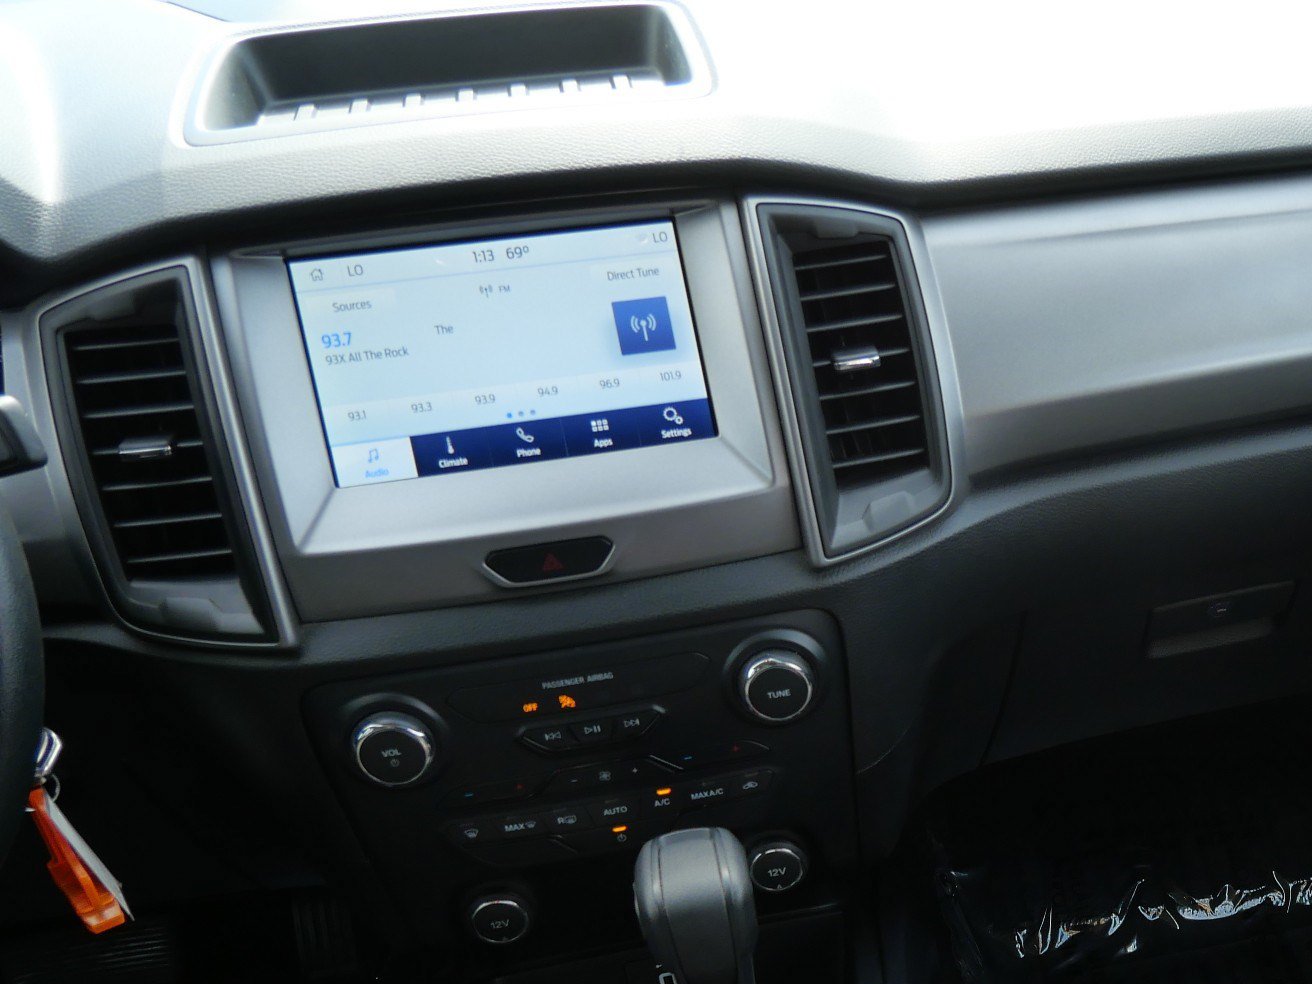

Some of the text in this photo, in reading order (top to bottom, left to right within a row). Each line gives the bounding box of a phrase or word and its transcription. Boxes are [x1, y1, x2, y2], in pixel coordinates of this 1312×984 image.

[653, 231, 668, 243] LO
[472, 249, 495, 263] 1:13
[347, 264, 364, 277] LO
[607, 267, 660, 281] Direct Tune
[332, 300, 372, 313] Sources
[434, 325, 454, 335] The
[321, 332, 352, 348] 93.7
[325, 346, 410, 366] 93X All The Rock
[348, 370, 682, 421] 93.1 93.3 93.9 94.9 96.9 101.9
[365, 427, 693, 479] Audio Climate Phone Apps Settings
[541, 671, 614, 690] PASSENGER AIRBAG
[767, 688, 792, 699] TUNE
[522, 702, 539, 713] OFF
[381, 749, 402, 758] VOL
[690, 789, 708, 800] MAX
[654, 798, 671, 808] A/C
[603, 805, 628, 817] AUTO
[504, 823, 526, 833] MAX
[767, 866, 787, 877] 12V
[490, 919, 510, 929] 12V
